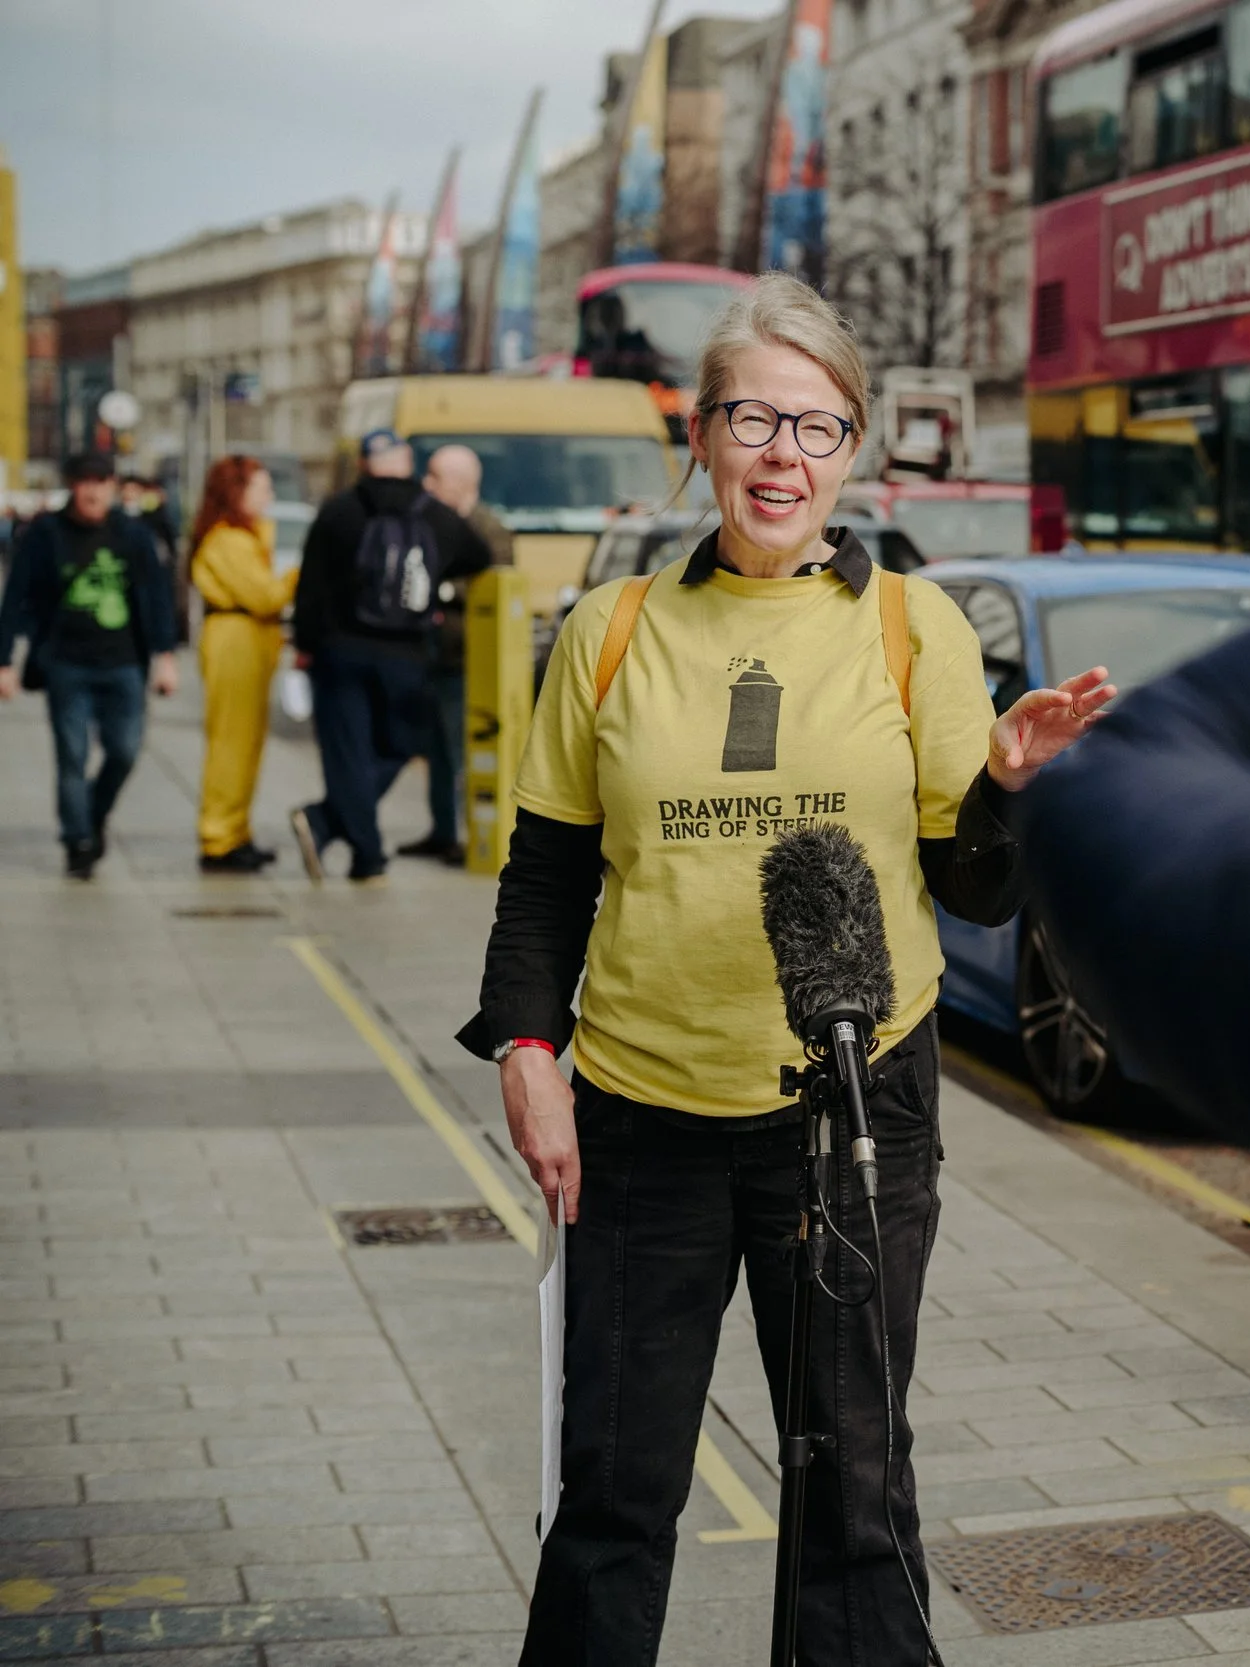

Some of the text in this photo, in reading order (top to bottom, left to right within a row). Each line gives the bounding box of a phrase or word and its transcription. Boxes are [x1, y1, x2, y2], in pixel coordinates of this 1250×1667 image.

[1145, 196, 1207, 263] DON'T
[658, 792, 846, 821] DRAWING THE
[662, 822, 710, 840] RING
[719, 821, 747, 838] OF
